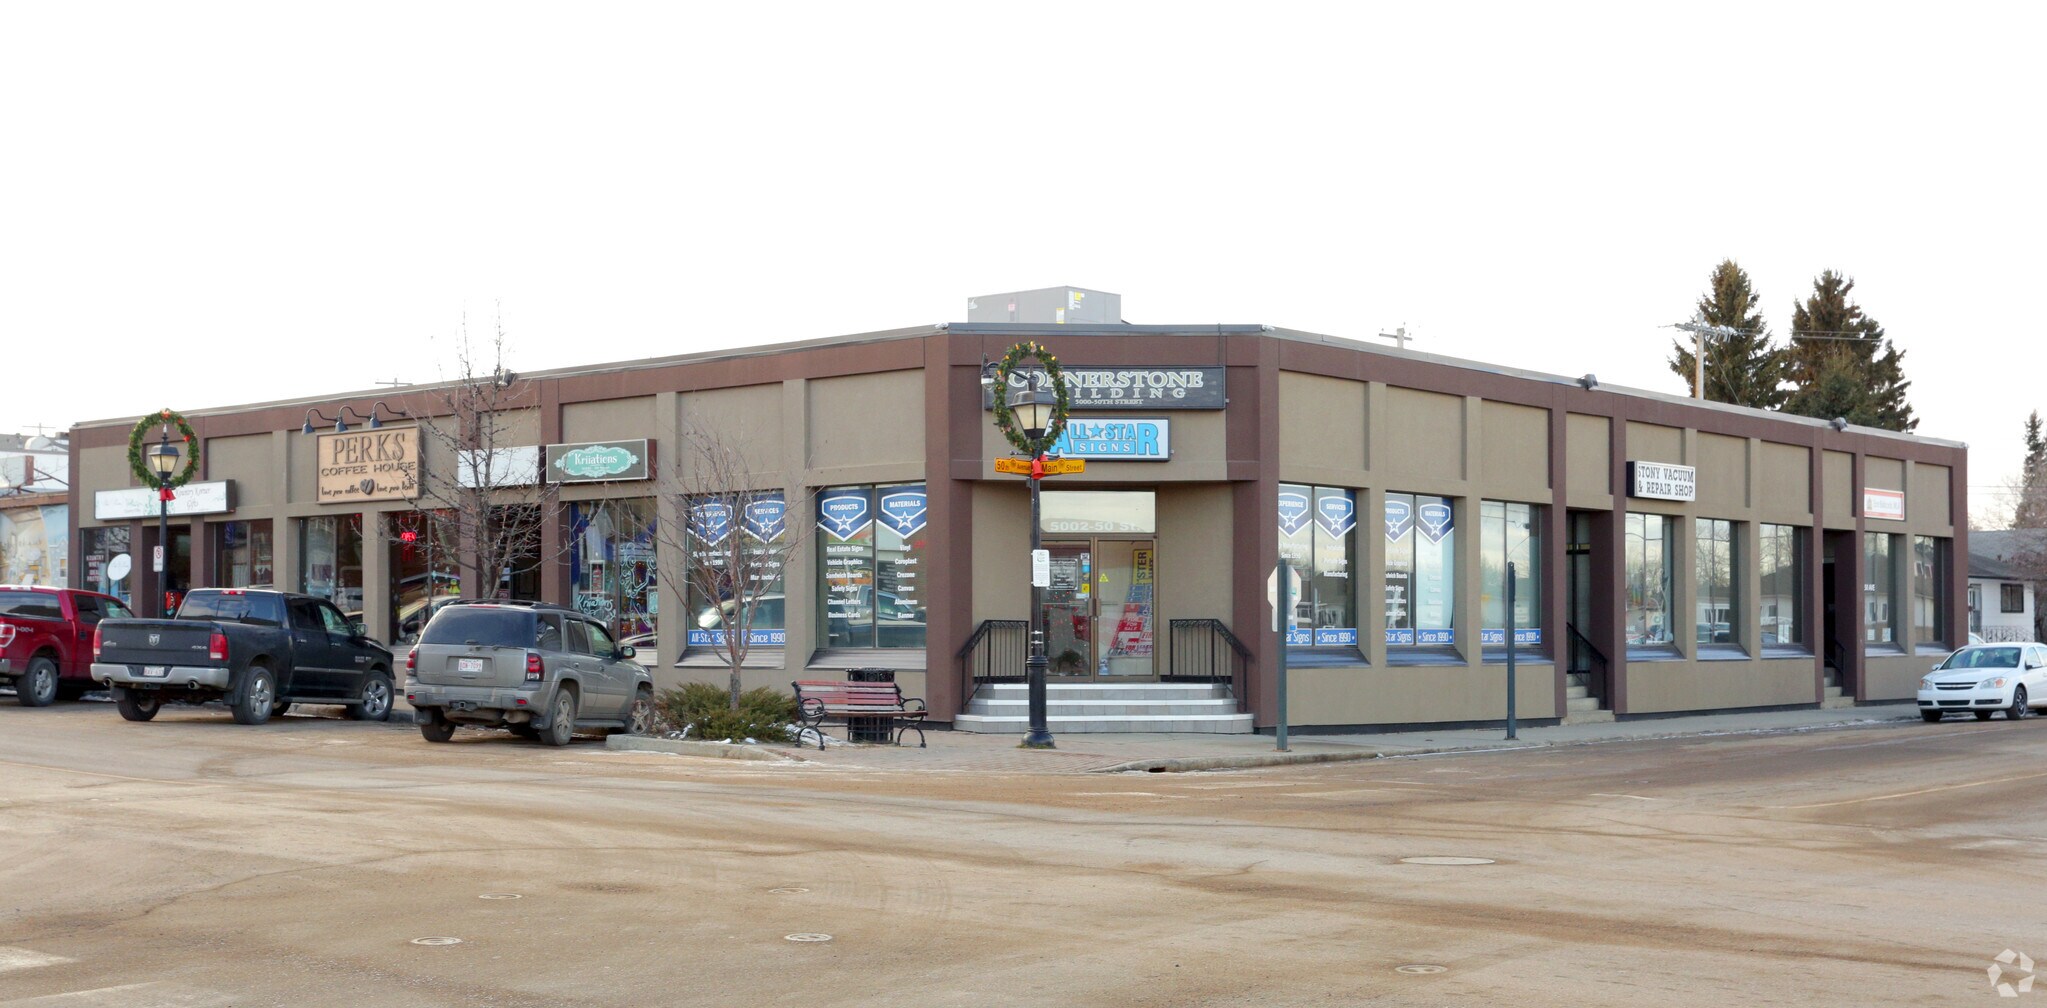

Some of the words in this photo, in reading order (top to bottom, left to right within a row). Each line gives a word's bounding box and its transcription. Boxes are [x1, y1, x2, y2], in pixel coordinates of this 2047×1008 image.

[1104, 422, 1159, 455] STAR
[332, 432, 405, 465] PERKS
[1079, 442, 1131, 452] SIGNS
[321, 465, 368, 477] COFFEE
[373, 461, 416, 473] HOUSE
[1041, 463, 1057, 473] Main
[1066, 464, 1082, 472] Street
[1638, 465, 1660, 480] STONY
[1663, 468, 1694, 483] VACUUM
[1646, 481, 1672, 496] REPAIR
[1675, 484, 1694, 497] SHOP
[829, 503, 859, 511] PRODUCTS
[889, 500, 921, 508] MATERIALS
[1326, 503, 1347, 511] SERVICES
[1050, 521, 1114, 531] 5002-50
[851, 545, 864, 553] Signs
[900, 544, 911, 552] Vinyl
[843, 558, 863, 566] Graphics
[894, 558, 917, 566] Coroplast
[749, 632, 768, 643] Since
[770, 631, 785, 643] 1990
[1293, 631, 1310, 644] Signs
[1321, 631, 1338, 643] Since
[1338, 631, 1351, 643] 1990
[1397, 631, 1412, 644] Signs
[1422, 631, 1437, 642] Since
[1437, 631, 1449, 642] 1990
[1489, 631, 1503, 643] Signs
[1514, 632, 1525, 641] ince
[1525, 631, 1536, 641] 1990
